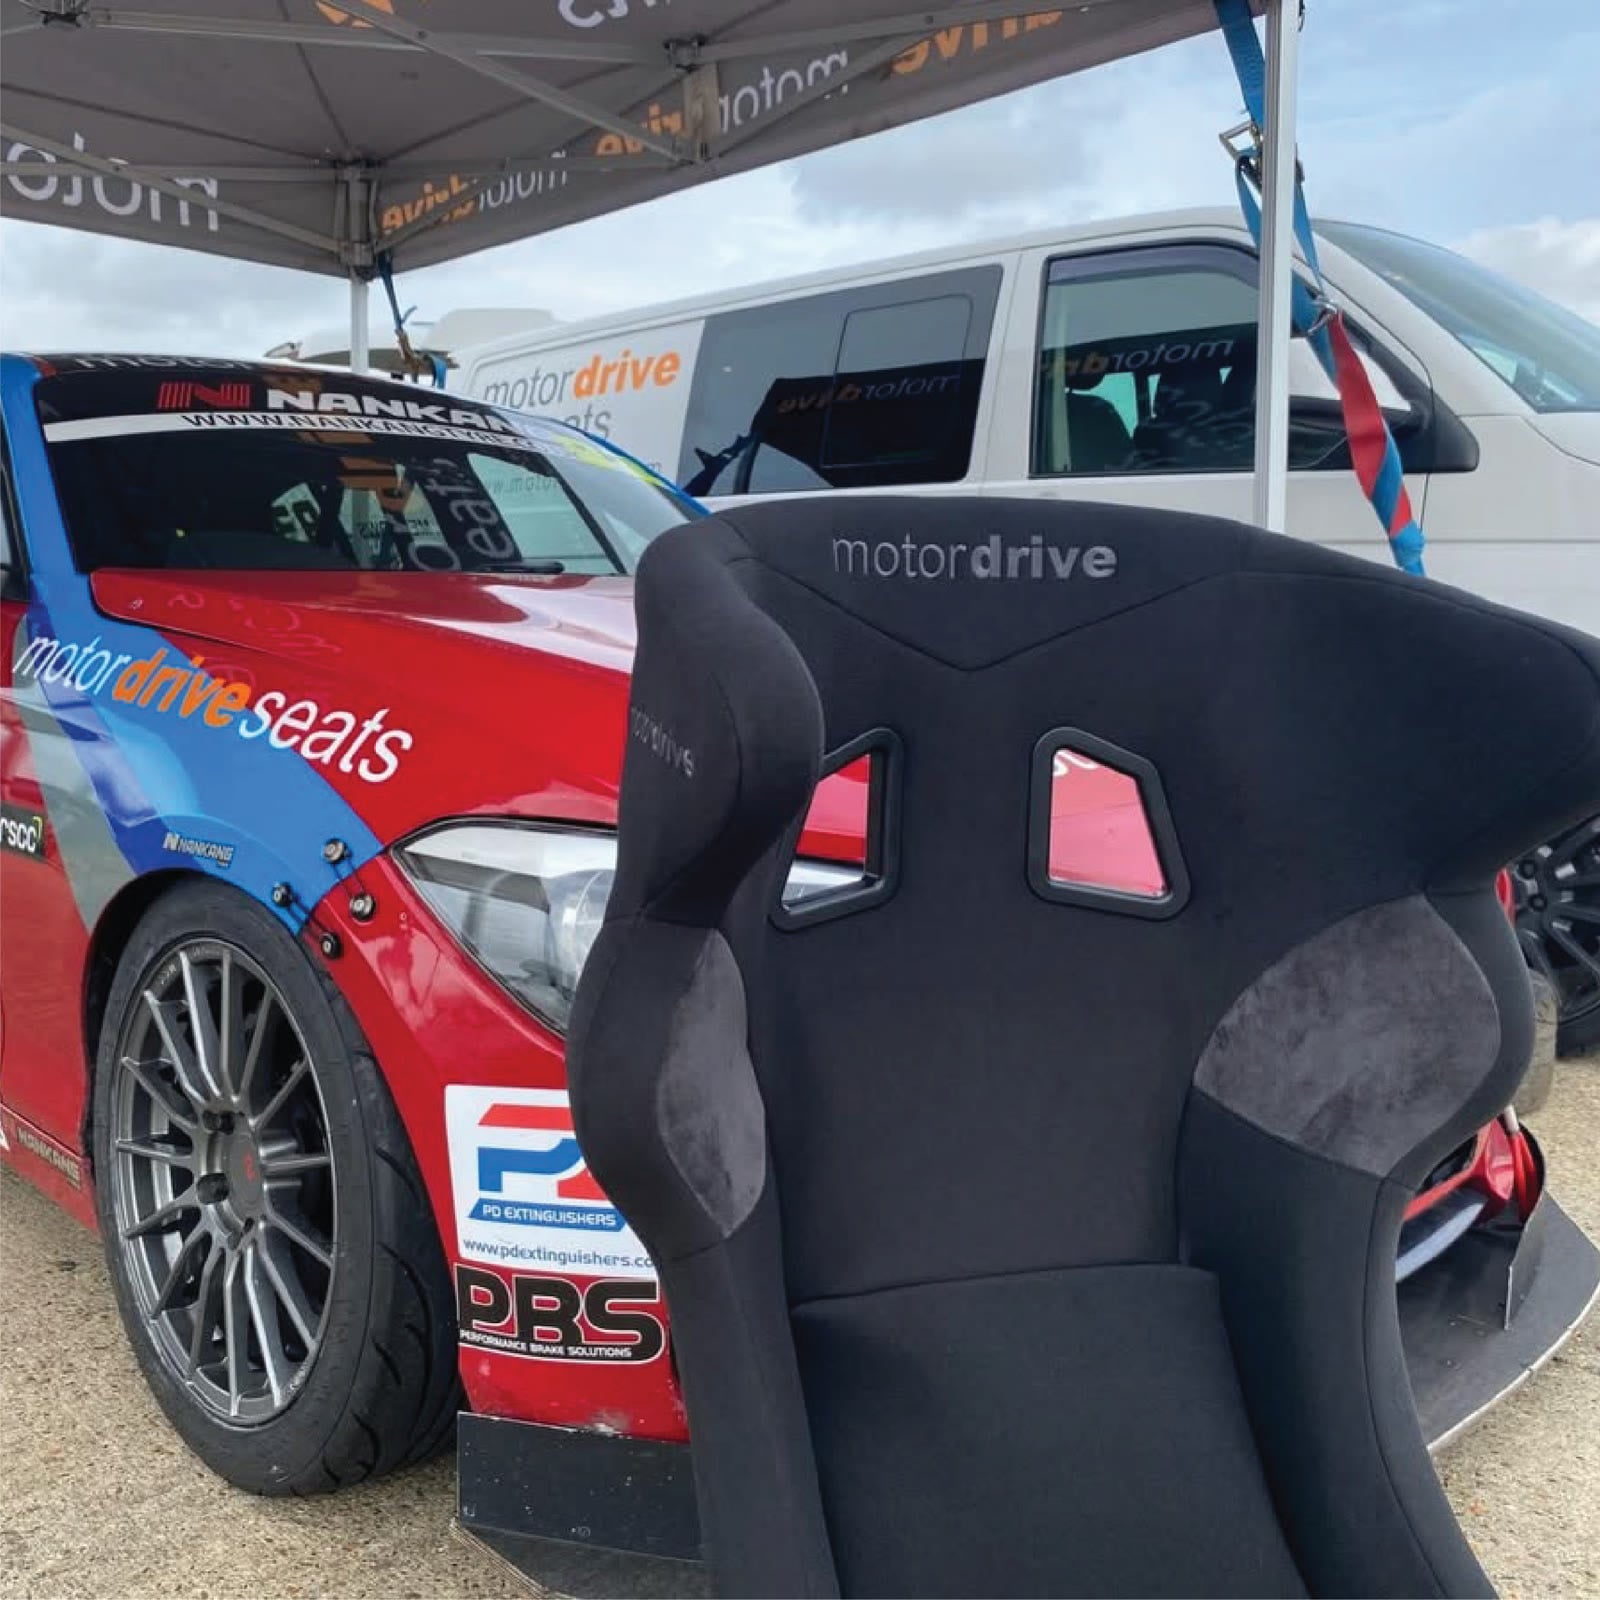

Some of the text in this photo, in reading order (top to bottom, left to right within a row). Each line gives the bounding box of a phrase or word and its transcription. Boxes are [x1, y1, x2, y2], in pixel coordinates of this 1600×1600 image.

[484, 350, 680, 410] motordrive
[832, 534, 1117, 579] motordrive
[482, 1204, 616, 1226] PD EXTINGUISHERS
[454, 1263, 665, 1364] PBS
[459, 1329, 632, 1358] PERFORMANCE BRAKE SOLUTIONS
